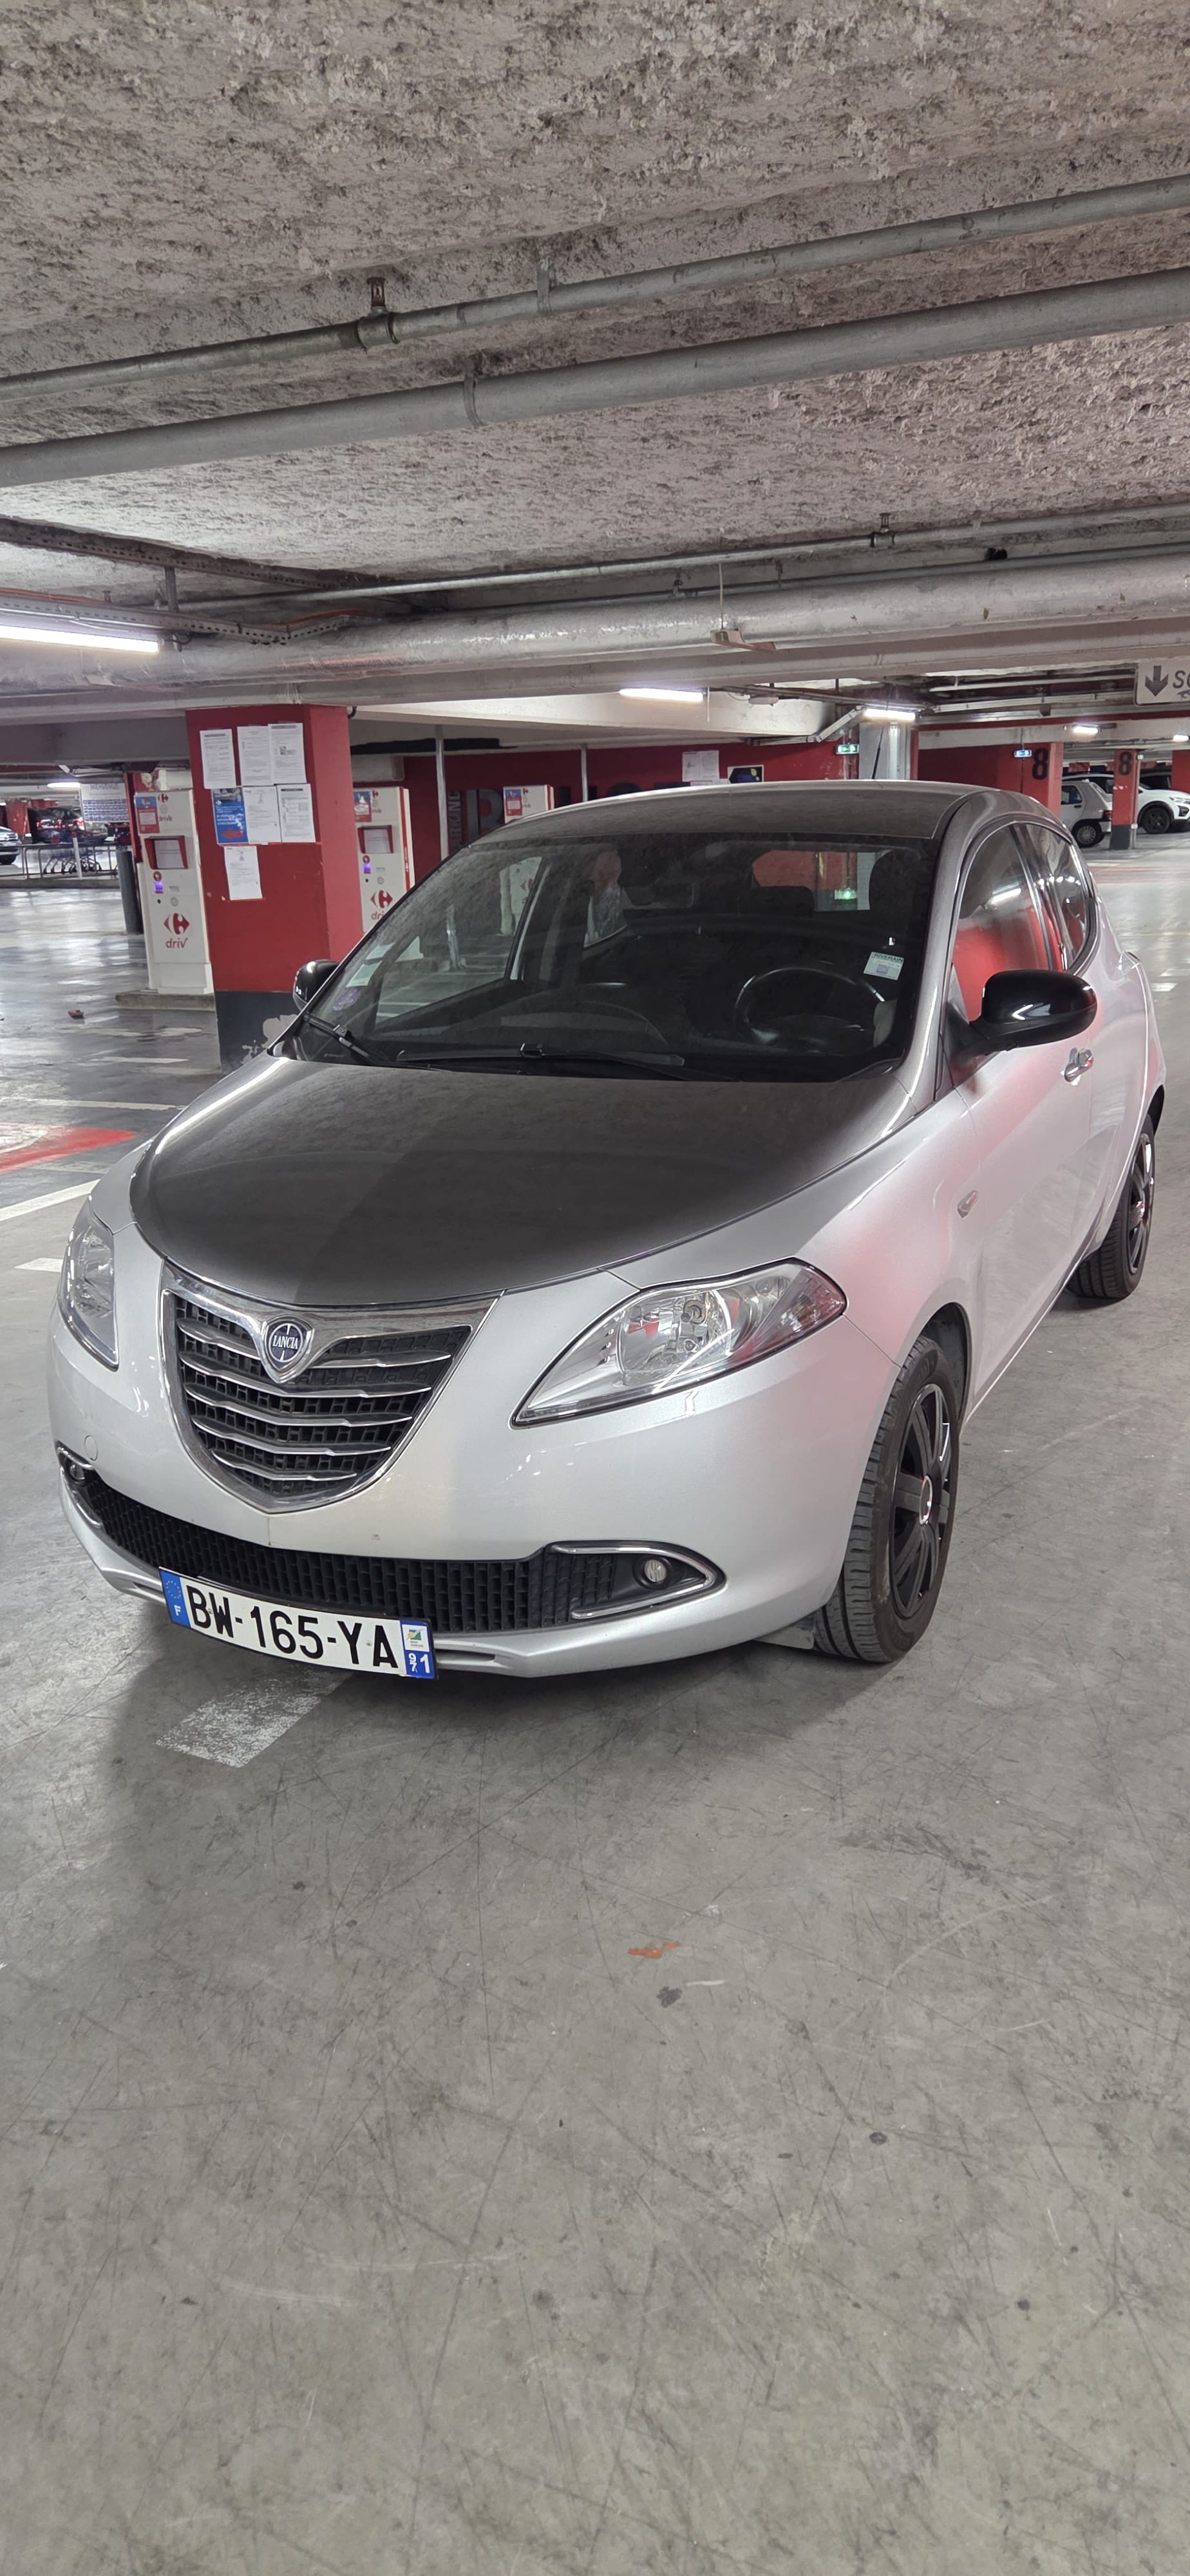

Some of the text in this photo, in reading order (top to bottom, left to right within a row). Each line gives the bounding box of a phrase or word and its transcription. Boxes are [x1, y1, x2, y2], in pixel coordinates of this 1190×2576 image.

[1032, 748, 1048, 780] 8
[1119, 752, 1132, 775] 8
[272, 1335, 298, 1350] LANCIA
[174, 1604, 181, 1616] F
[186, 1585, 399, 1669] BW-165-YA
